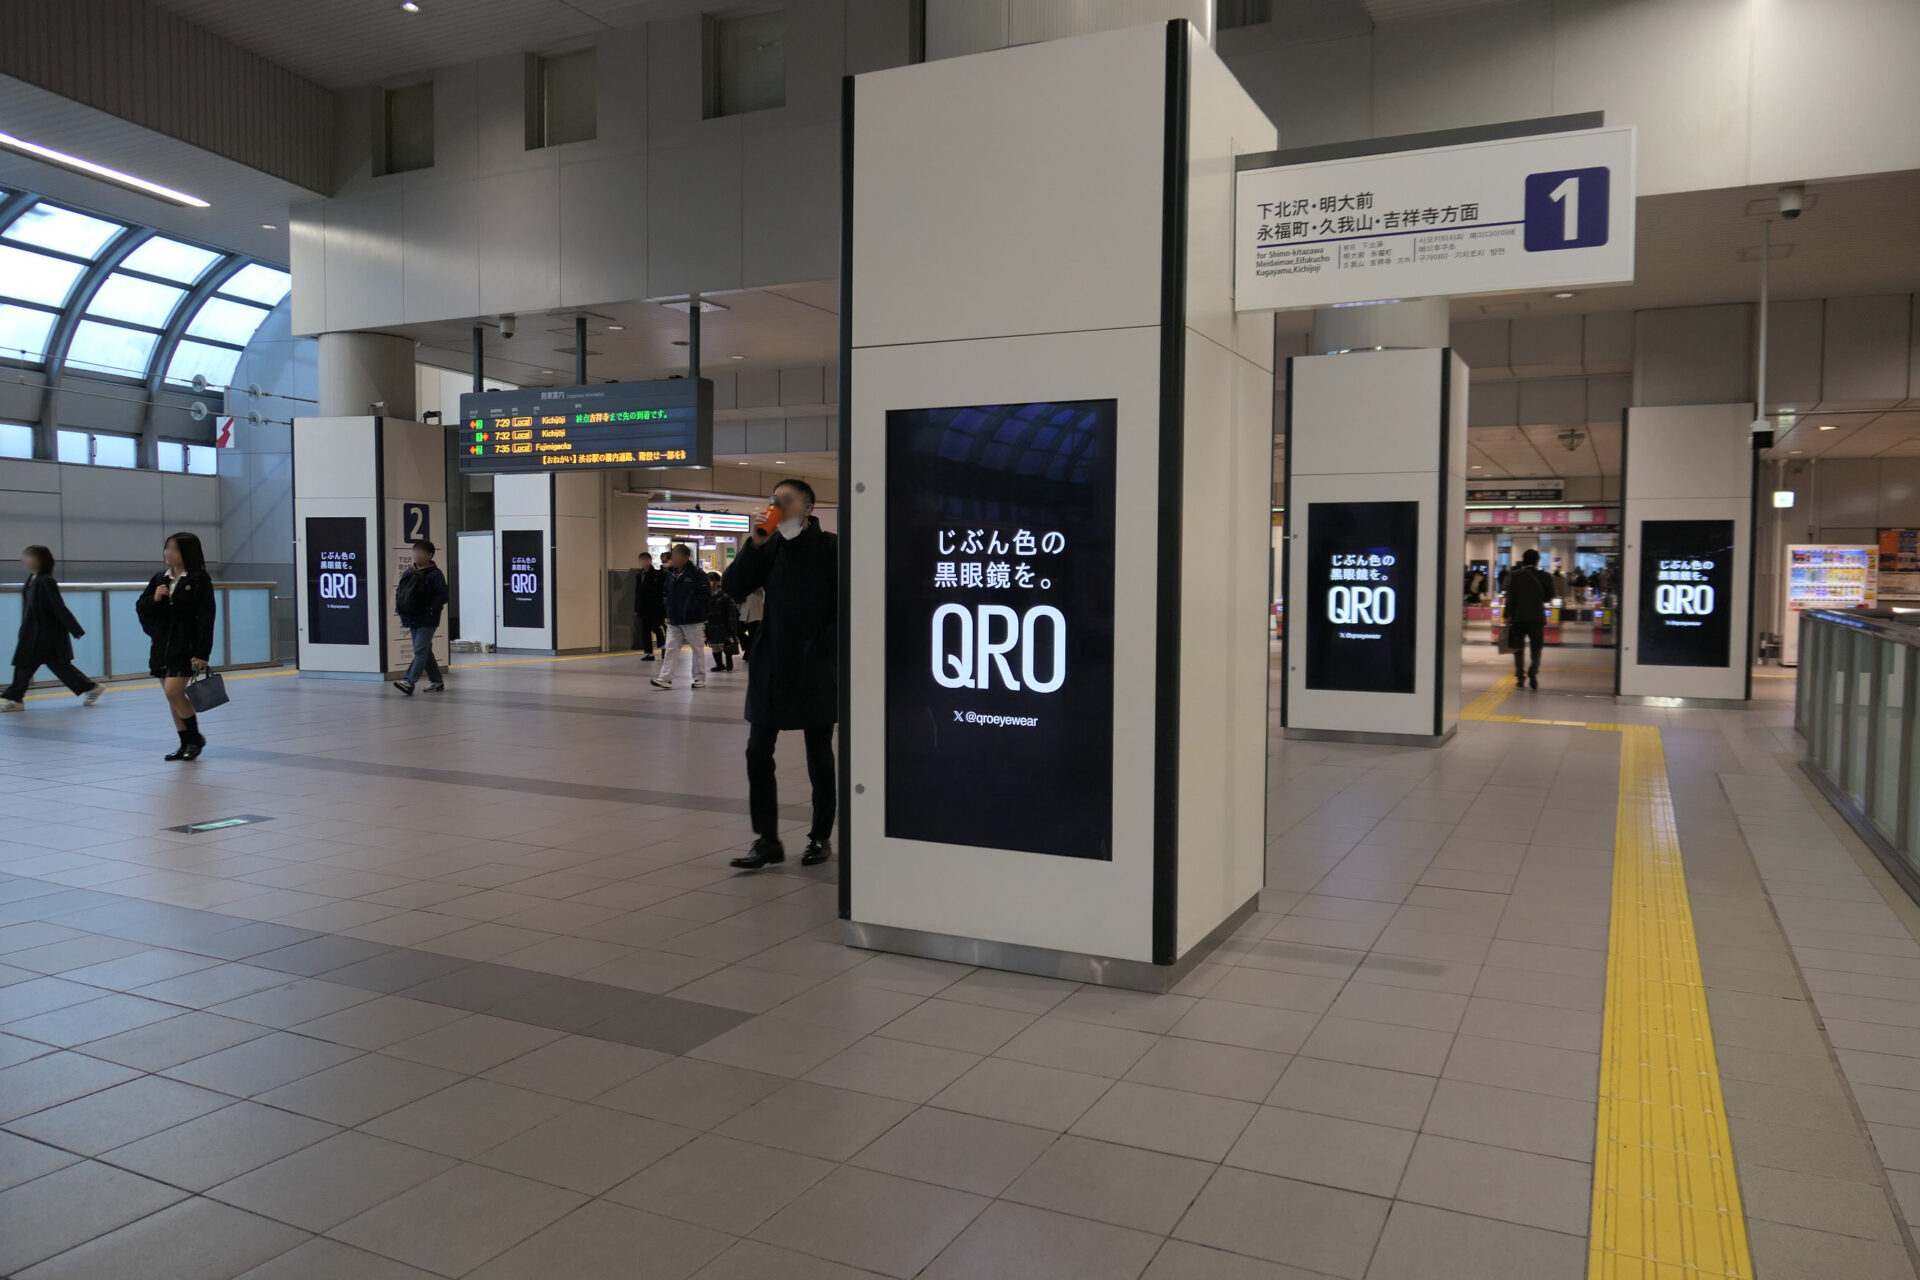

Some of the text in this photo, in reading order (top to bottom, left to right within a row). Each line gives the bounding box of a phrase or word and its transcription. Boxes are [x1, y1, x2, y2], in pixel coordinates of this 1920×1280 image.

[1257, 192, 1374, 220] 下北沢・明大前
[1549, 177, 1579, 241] 1
[1257, 203, 1479, 241] 永福町・久我山・吉祥寺方面
[1269, 248, 1324, 258] Shimo-kitazawa
[495, 419, 511, 428] 7:29
[514, 418, 531, 426] Local
[495, 432, 511, 441] 7:32
[514, 431, 531, 439] Local
[495, 445, 511, 454] 7:35
[514, 444, 531, 452] Local
[535, 443, 572, 452] Fujimigaoka
[410, 507, 424, 540] 2
[939, 529, 1066, 556] じぶん色の
[321, 552, 356, 560] じぶん色の
[1332, 554, 1395, 567] じぶん色の
[320, 573, 357, 599] QRO
[511, 573, 537, 593] QRO
[934, 561, 1051, 589] 黒眼鏡を。
[1328, 586, 1396, 625] QRO
[1656, 584, 1715, 615] QRO
[932, 603, 1066, 693] QRO
[966, 711, 1038, 727] @qroeyewear
